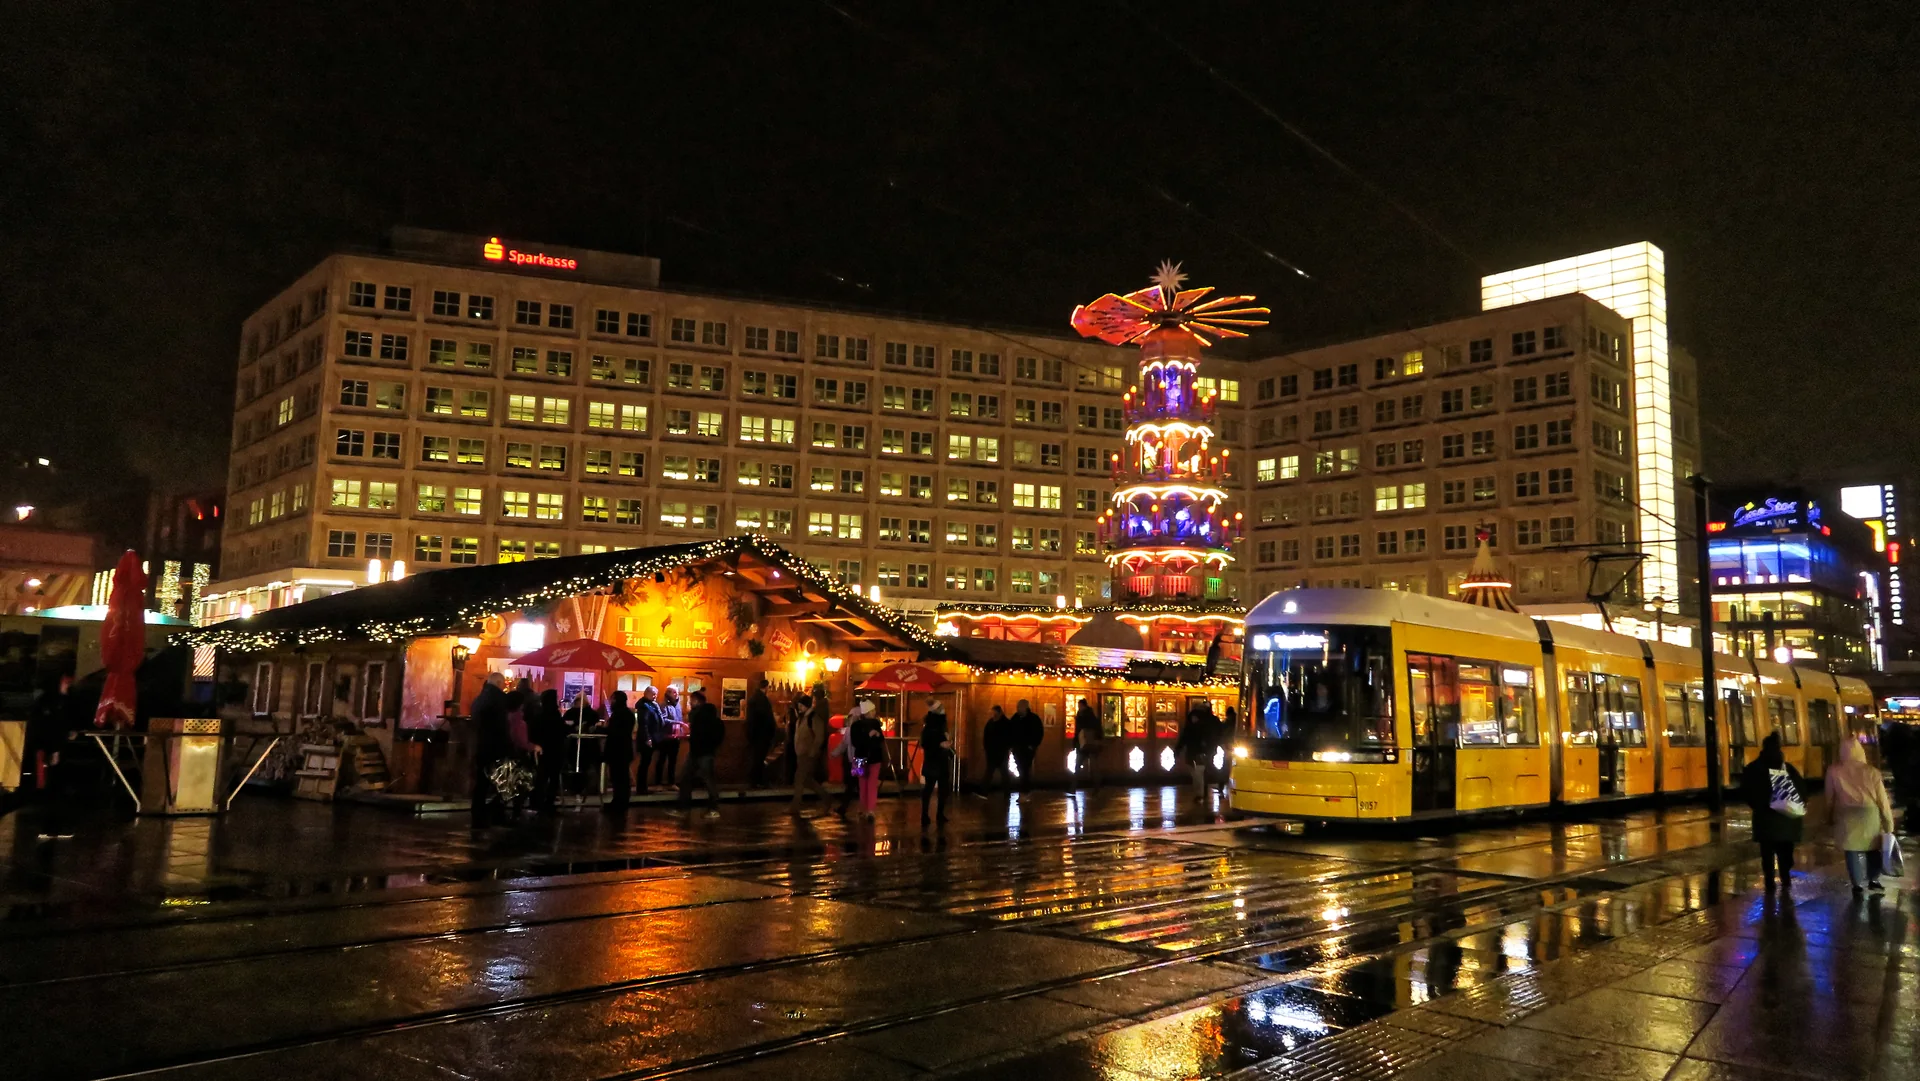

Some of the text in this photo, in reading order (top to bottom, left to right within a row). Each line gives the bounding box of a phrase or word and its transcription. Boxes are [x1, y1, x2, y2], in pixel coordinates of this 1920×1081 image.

[508, 249, 577, 270] Sparkasse
[624, 632, 651, 648] Zum
[656, 634, 709, 650] Steinbock
[1359, 800, 1379, 811] 9057
